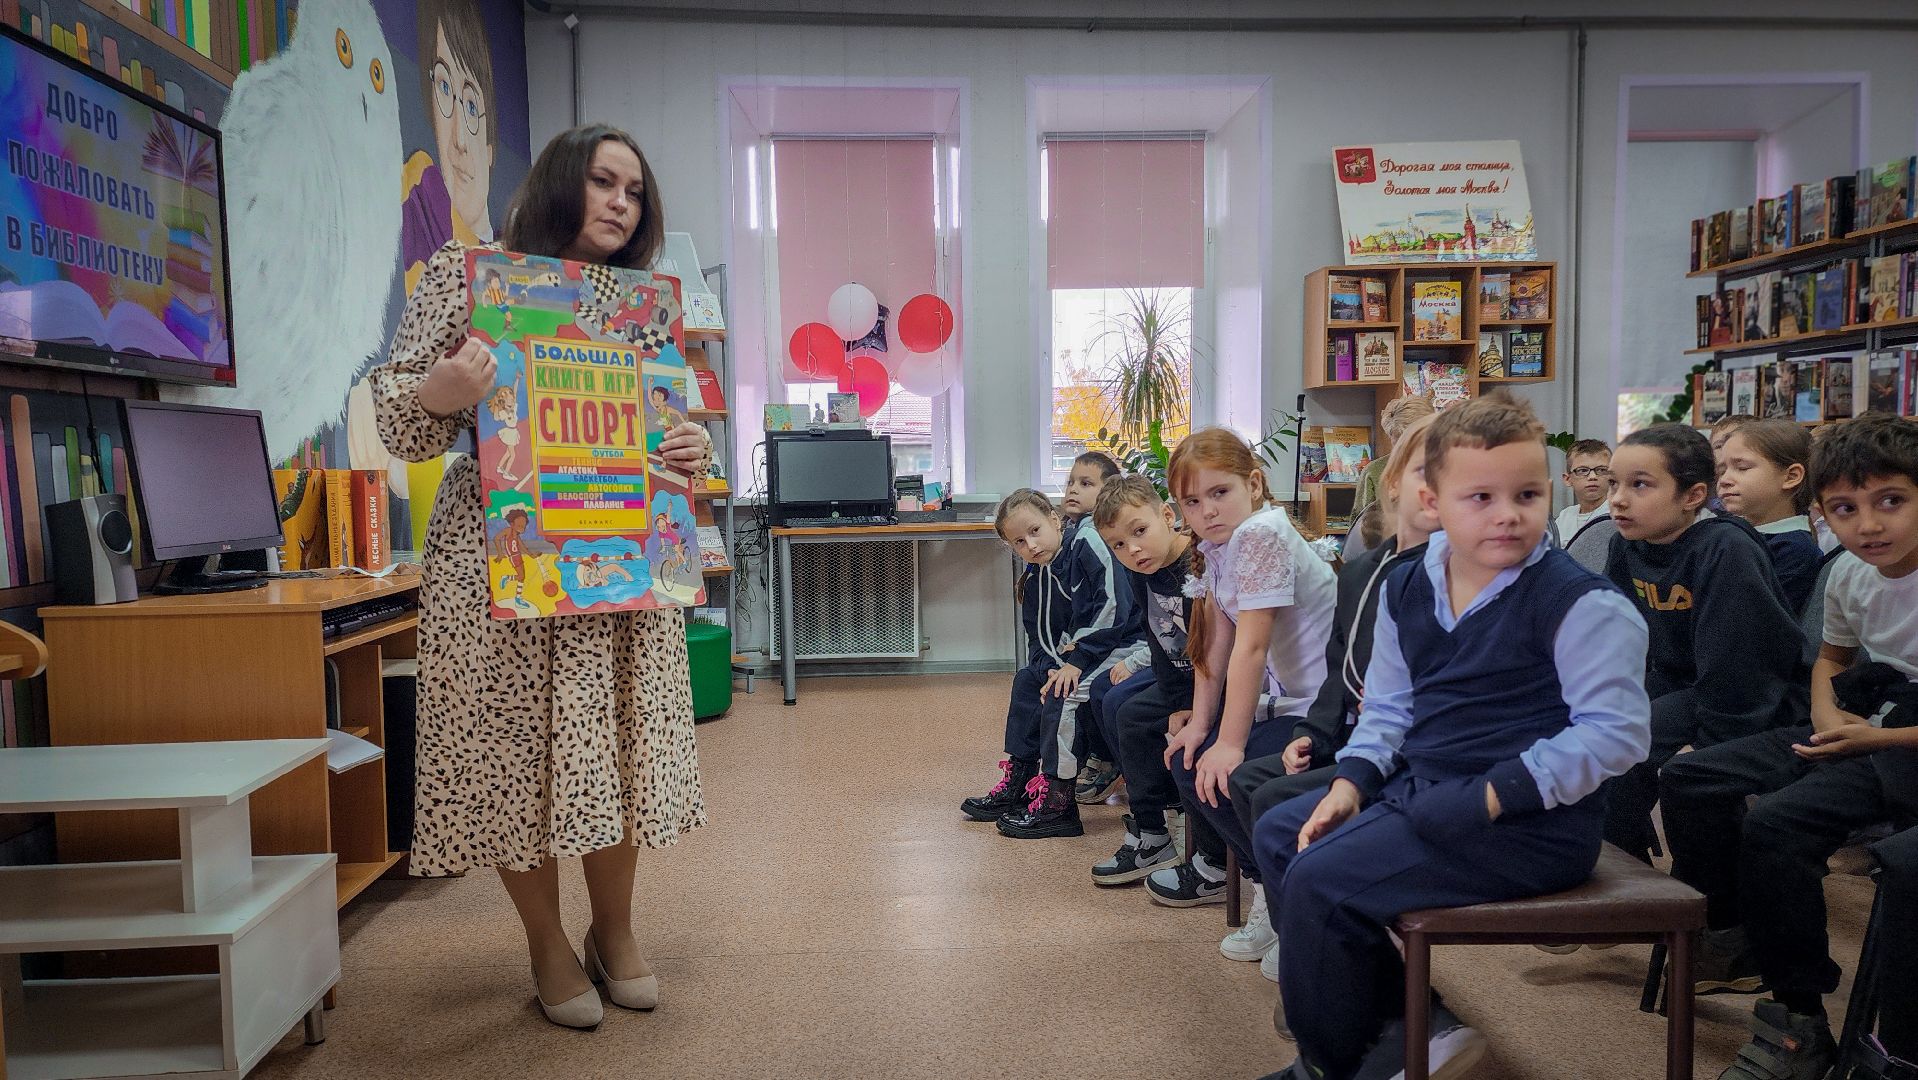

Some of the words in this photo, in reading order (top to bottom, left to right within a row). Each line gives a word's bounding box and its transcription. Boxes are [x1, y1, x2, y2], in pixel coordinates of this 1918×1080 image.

[47, 82, 118, 141] ДОБРО
[1380, 159, 1435, 176] Дорогая
[1439, 163, 1461, 171] моя
[8, 139, 155, 221] ПОЖАЛОВАТЬ
[1384, 180, 1430, 195] Золотая
[1436, 186, 1457, 194] моя
[6, 215, 23, 251] В
[30, 221, 164, 286] БИБЛИОТЕКУ
[534, 344, 635, 367] БОЛЬШАЯ
[535, 366, 595, 392] КНИГА
[603, 370, 636, 395] ИГР
[539, 397, 637, 446] СПОРТ
[592, 448, 625, 458] ФУТБОЛ
[558, 466, 598, 475] АТЛЕТИКА
[573, 474, 618, 483] БАСКЕТБОЛ
[557, 492, 603, 501] ВЕЛОСПОРТ
[588, 483, 633, 493] АВТОГОНКИ
[583, 501, 625, 509] ПЛАВАНИЕ
[1632, 577, 1693, 611] FILA
